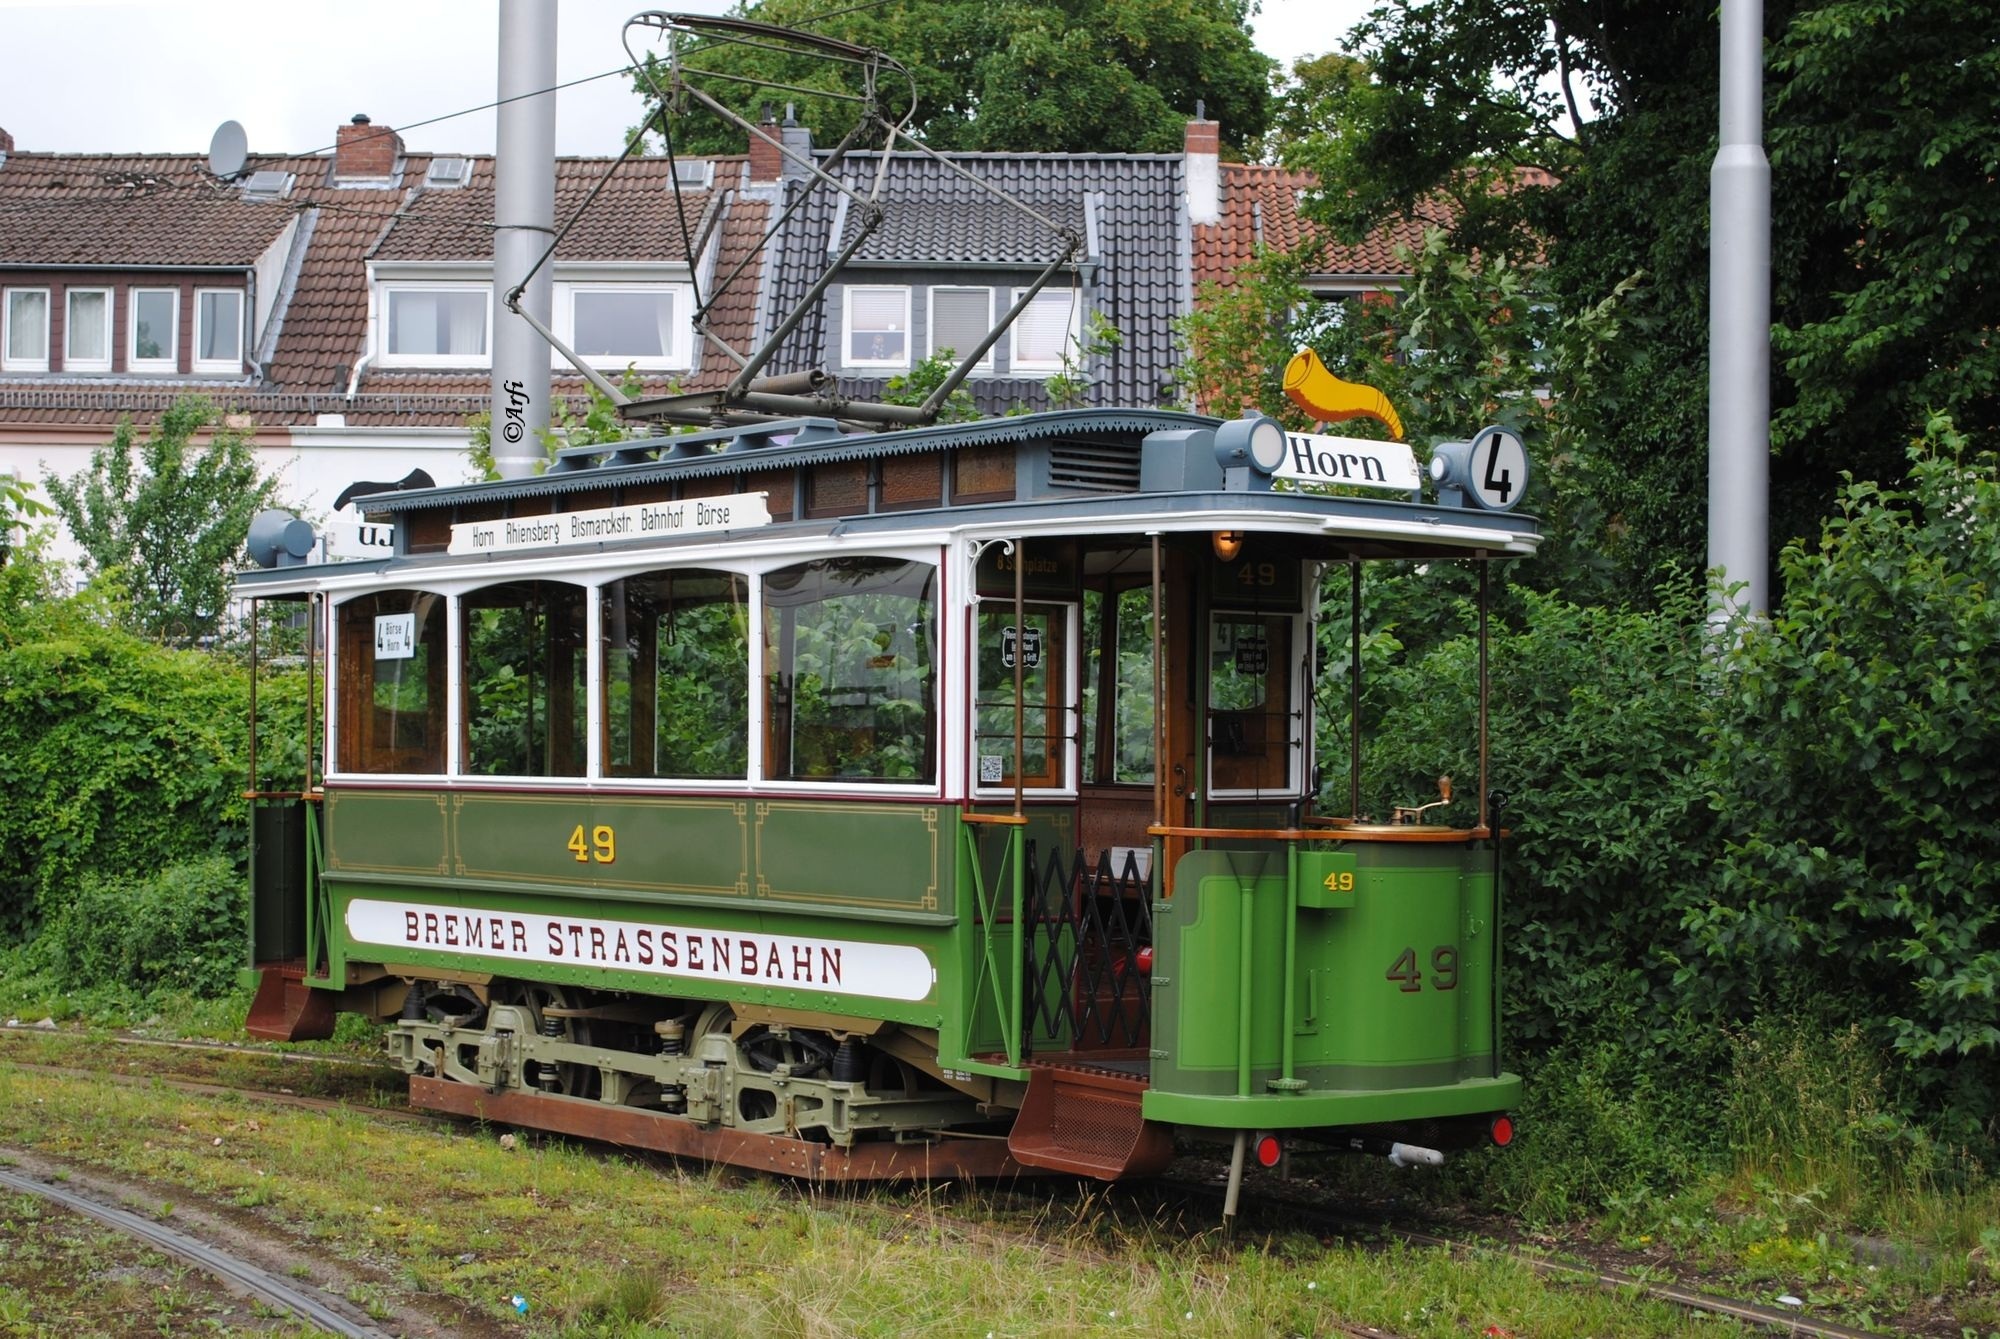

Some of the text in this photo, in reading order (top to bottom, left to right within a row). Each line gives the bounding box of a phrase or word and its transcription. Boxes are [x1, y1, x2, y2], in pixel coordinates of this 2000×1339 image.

[1289, 436, 1387, 482] Horn
[1484, 433, 1512, 503] 4
[473, 502, 730, 547] Horn Rhiensberg Bismarckstr. Bahnhof Börse
[1237, 561, 1275, 585] 49
[377, 622, 384, 652] 4
[385, 622, 402, 635] Börse
[404, 620, 412, 651] 4
[567, 824, 616, 864] 49
[1324, 872, 1354, 892] 49
[405, 911, 842, 985] BREMER STRASSENBAHN
[1386, 945, 1458, 992] 49
